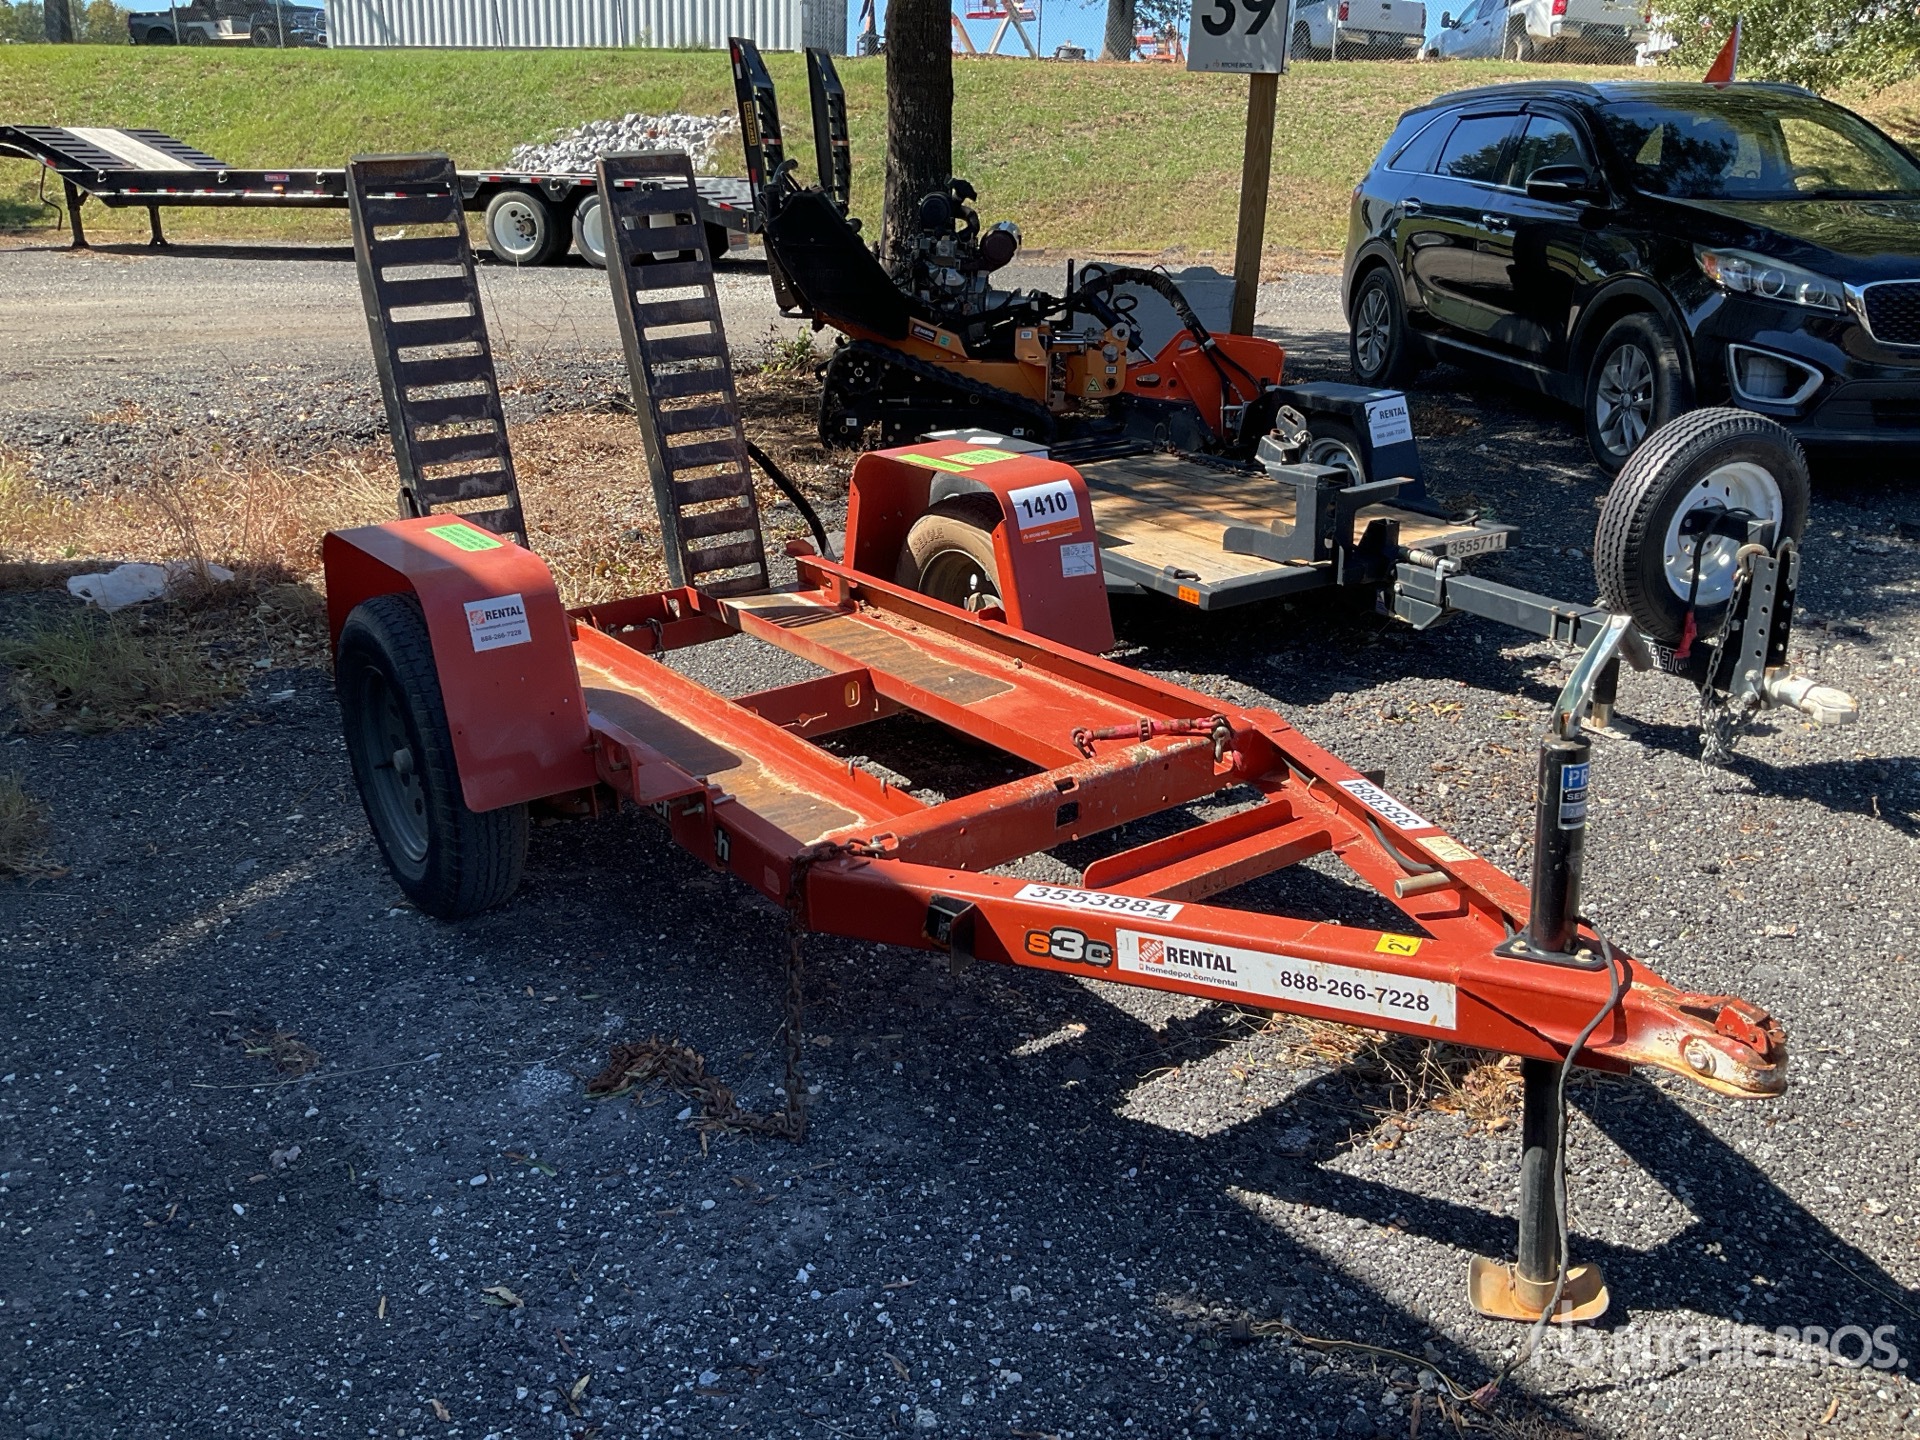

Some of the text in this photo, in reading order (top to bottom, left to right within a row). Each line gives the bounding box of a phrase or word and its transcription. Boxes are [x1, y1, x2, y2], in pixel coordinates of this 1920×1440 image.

[1201, 0, 1276, 36] 39
[1379, 406, 1406, 419] RENTAL
[1022, 492, 1068, 518] 1410
[1450, 534, 1502, 556] 3555711
[485, 606, 523, 620] RENTAL
[1344, 781, 1420, 827] 3553884
[1029, 886, 1171, 917] 3553884
[1139, 940, 1237, 974] HOME RENTAL
[1145, 964, 1238, 988] homedepot.com/rental
[1280, 970, 1430, 1012] 888-266-7228
